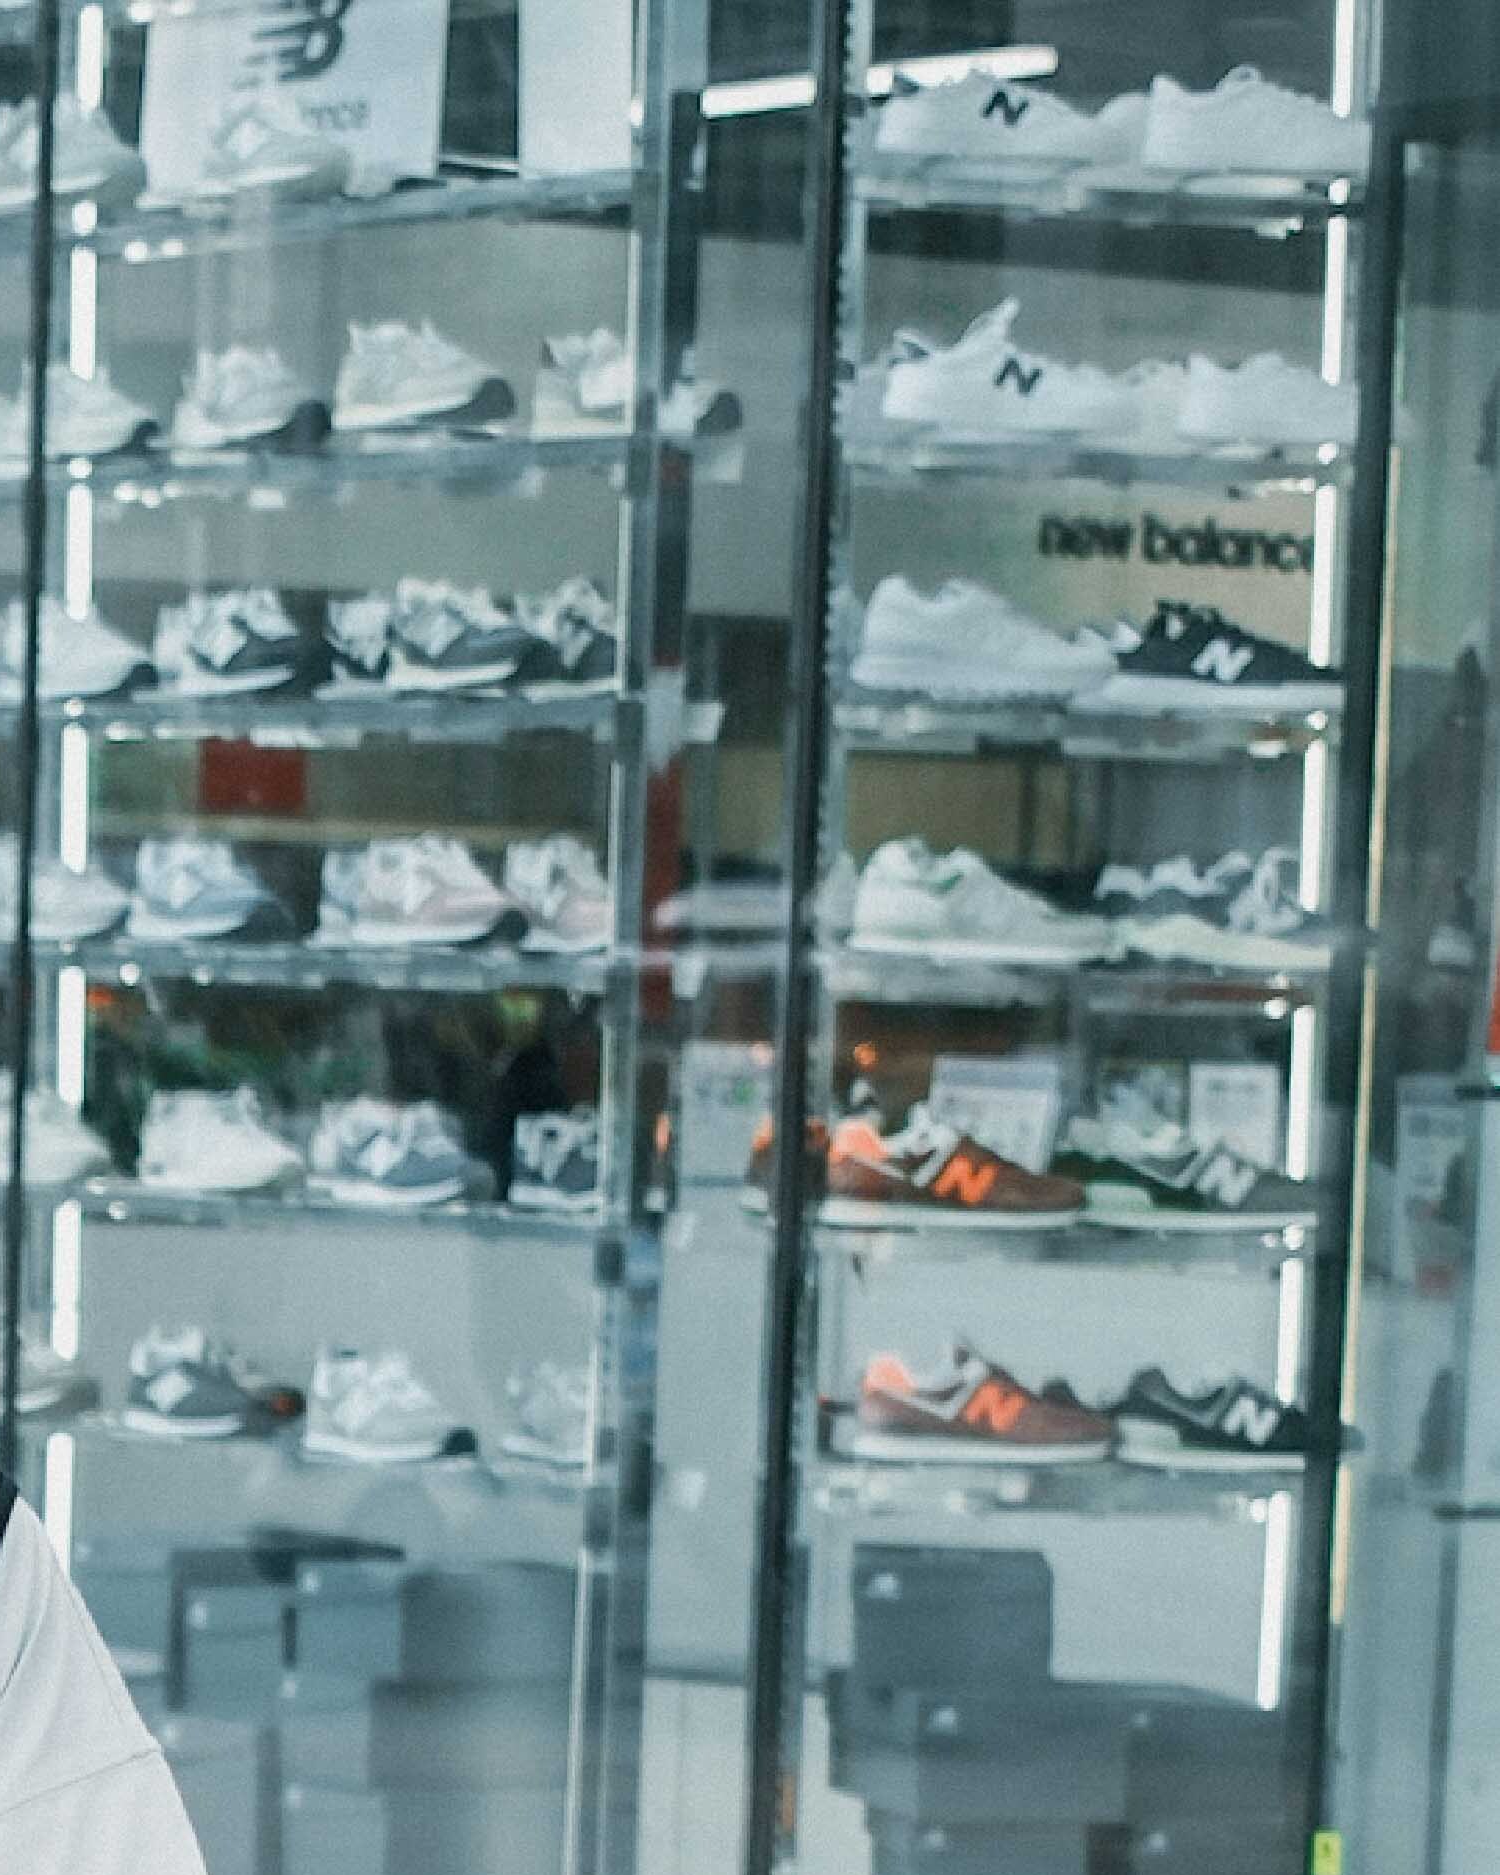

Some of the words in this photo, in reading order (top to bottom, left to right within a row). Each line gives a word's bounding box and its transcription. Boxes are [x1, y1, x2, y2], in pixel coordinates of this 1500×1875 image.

[1038, 514, 1132, 560] new
[1193, 640, 1252, 680] N
[935, 1163, 996, 1205] N
[966, 1382, 1027, 1430] N
[1224, 1395, 1278, 1443] N
